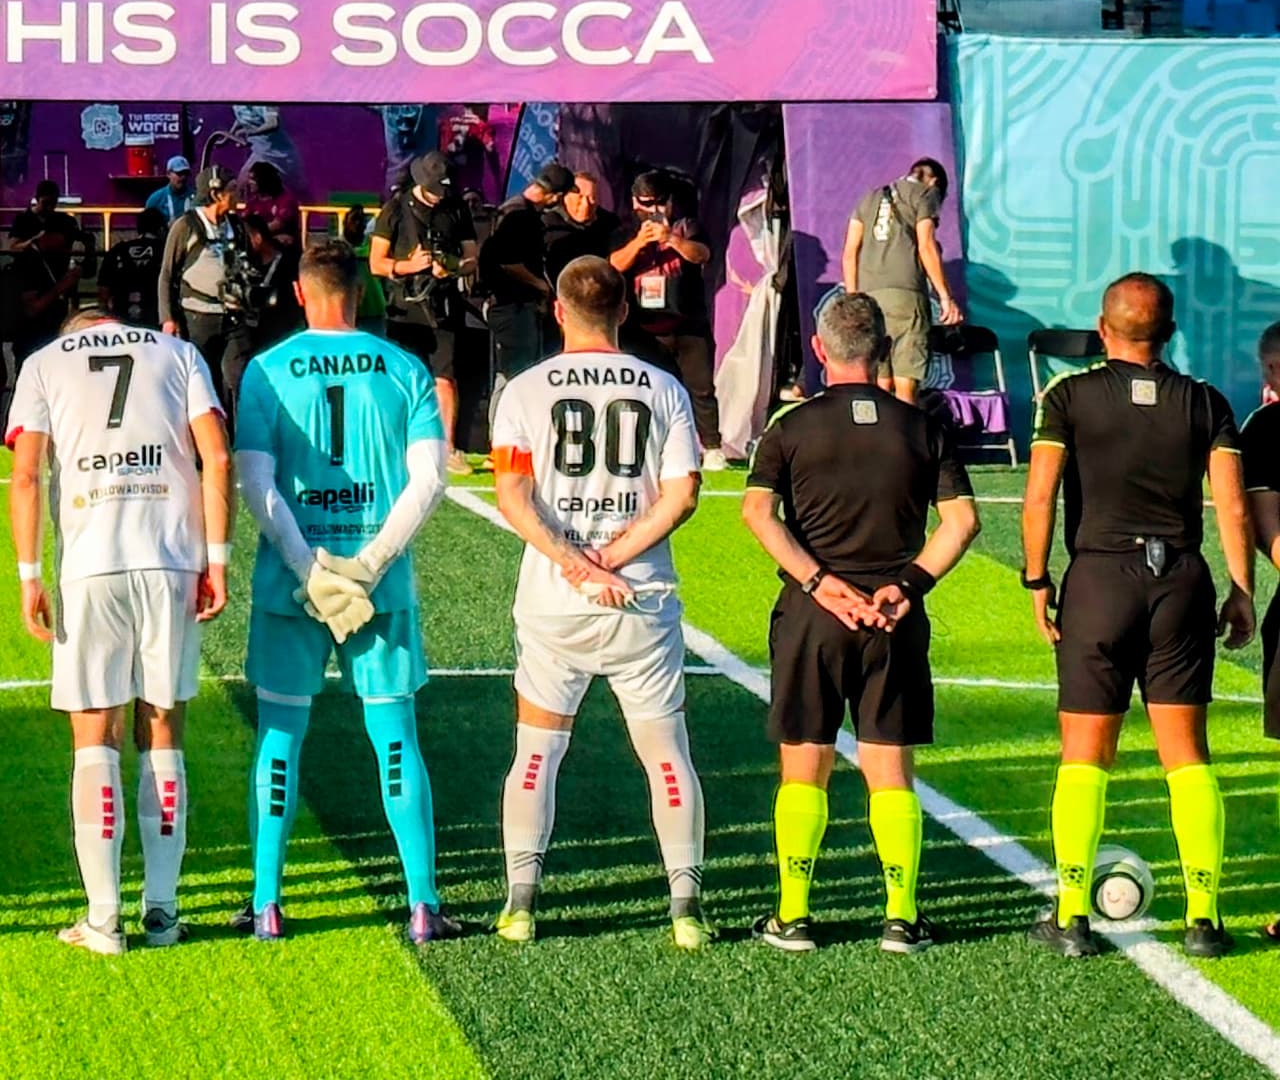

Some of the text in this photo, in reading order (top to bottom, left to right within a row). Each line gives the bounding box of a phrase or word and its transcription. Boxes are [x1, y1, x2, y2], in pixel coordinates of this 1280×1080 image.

[209, 1, 302, 66] IS
[330, 0, 715, 66] SOCCA
[61, 330, 158, 352] CANADA
[289, 353, 388, 379] CANADA
[547, 367, 653, 390] CANADA
[88, 353, 135, 430] 7
[325, 384, 345, 466] 1
[551, 398, 653, 478] 80
[77, 444, 163, 474] capelli
[117, 468, 160, 477] SPORT
[296, 481, 375, 512] capelli
[557, 491, 638, 518] capelli
